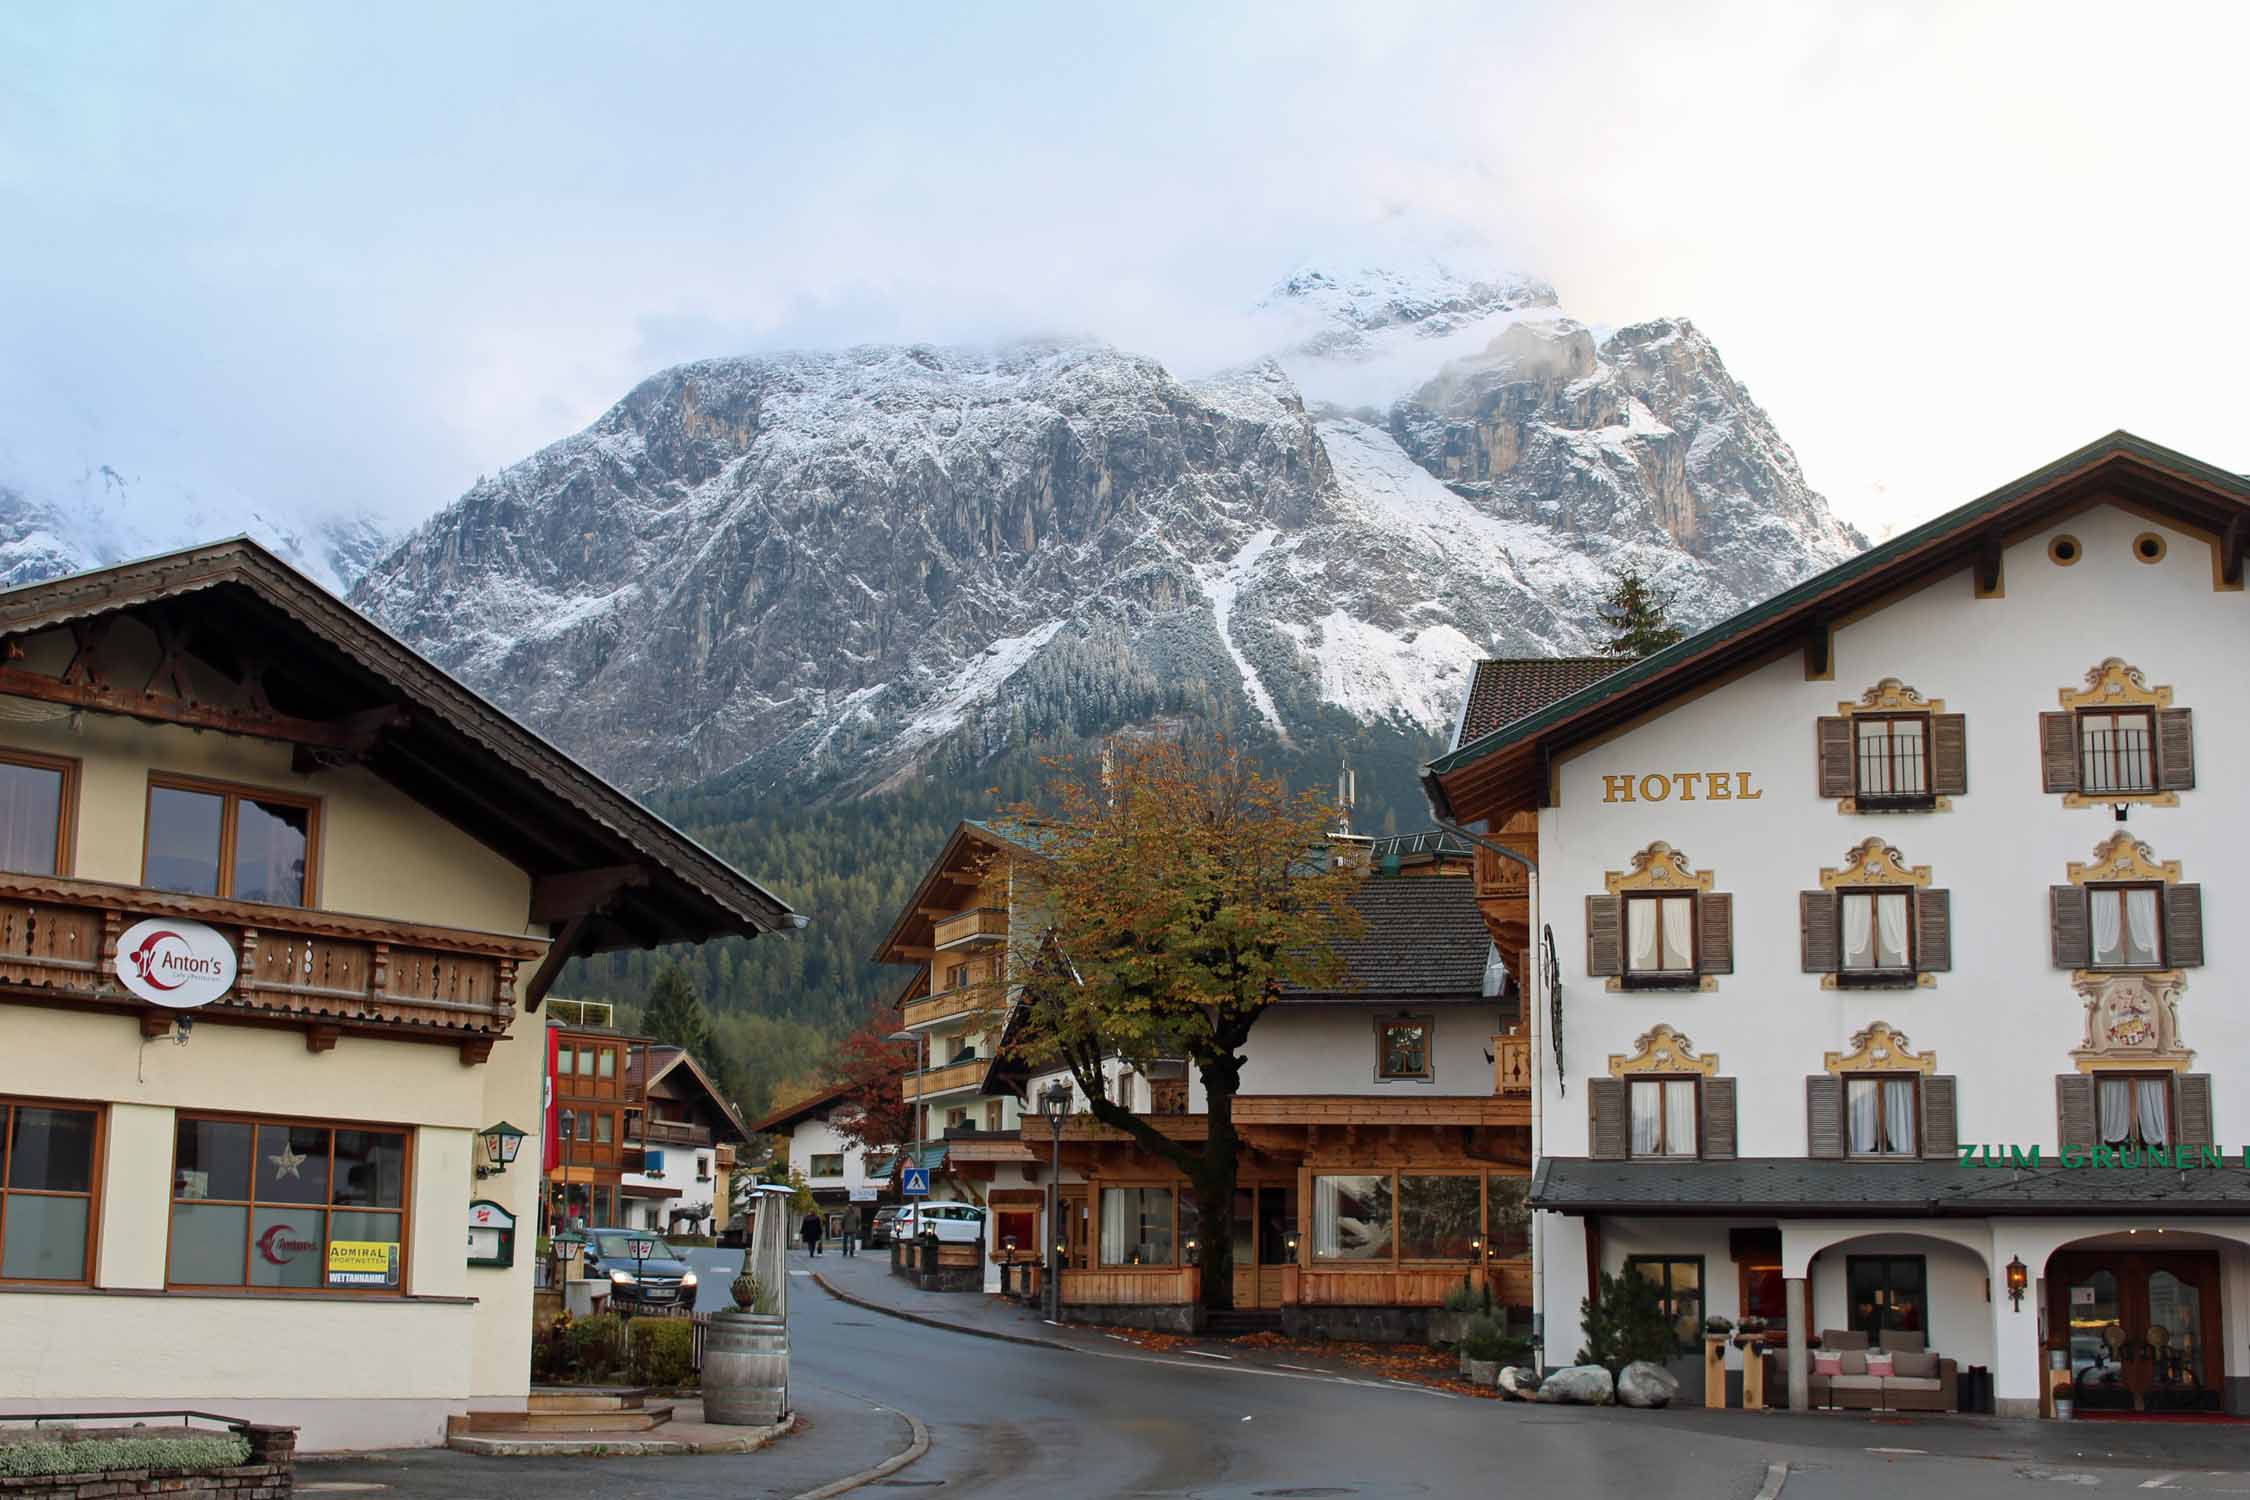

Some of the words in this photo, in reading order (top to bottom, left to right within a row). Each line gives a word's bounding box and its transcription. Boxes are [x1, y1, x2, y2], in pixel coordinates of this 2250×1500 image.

[1602, 772, 1763, 803] HOTEL
[161, 950, 222, 975] Anton's
[1957, 1144, 2041, 1169] ZUM
[2060, 1139, 2223, 1169] GRÜNEN
[330, 1247, 387, 1258] ADMIRAL
